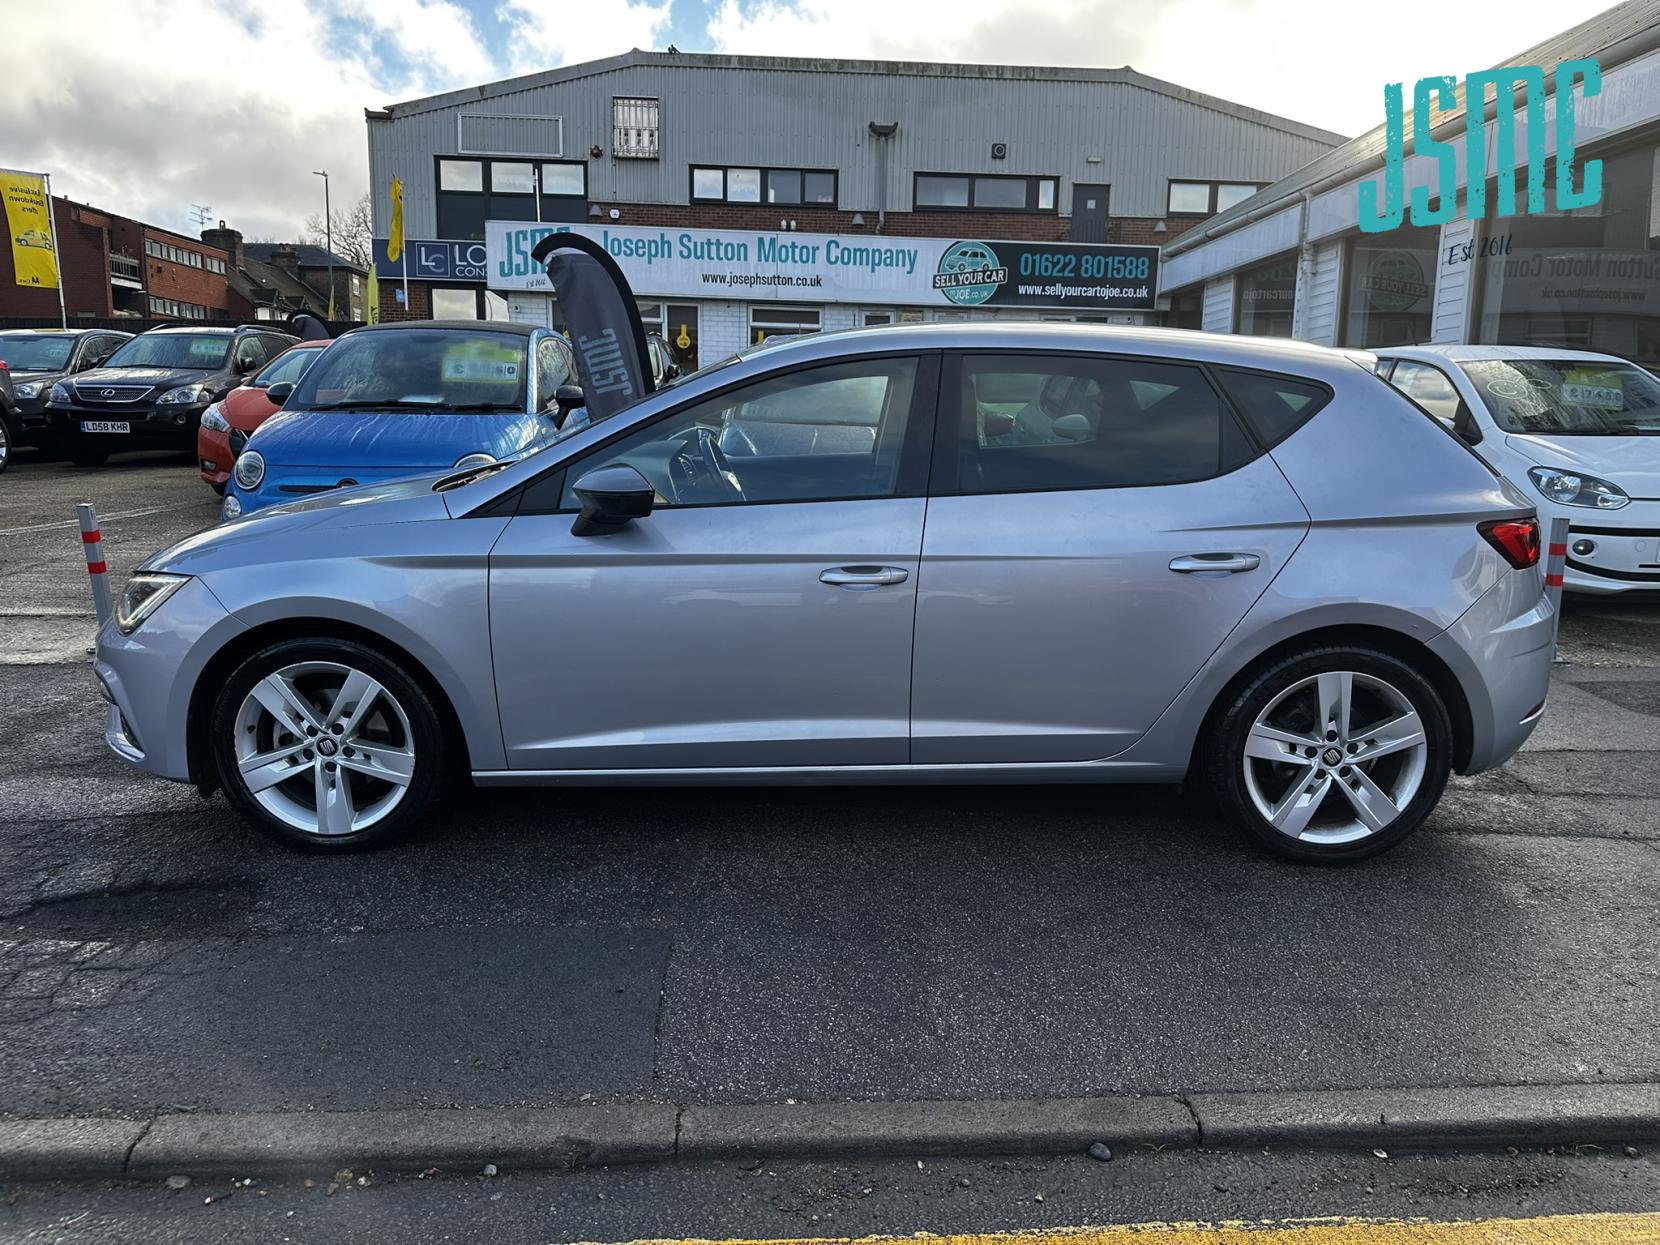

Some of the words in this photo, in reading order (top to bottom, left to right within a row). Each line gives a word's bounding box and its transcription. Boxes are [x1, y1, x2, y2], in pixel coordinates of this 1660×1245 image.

[603, 230, 672, 264] Joseph
[679, 233, 748, 262] Sutton
[757, 236, 819, 264] Motor
[825, 239, 918, 274] Company
[1020, 253, 1077, 278] 01622
[1080, 255, 1149, 279] 801588
[702, 272, 822, 288] www.josephsutton.co.uk
[935, 275, 957, 288] SELL
[958, 272, 983, 285] YOUR
[984, 269, 1005, 283] CAR
[1018, 283, 1148, 300] www.sellyourcartojoe.co.uk
[579, 328, 633, 396] JSMC
[86, 422, 109, 431] LD58
[110, 422, 129, 432] KHR
